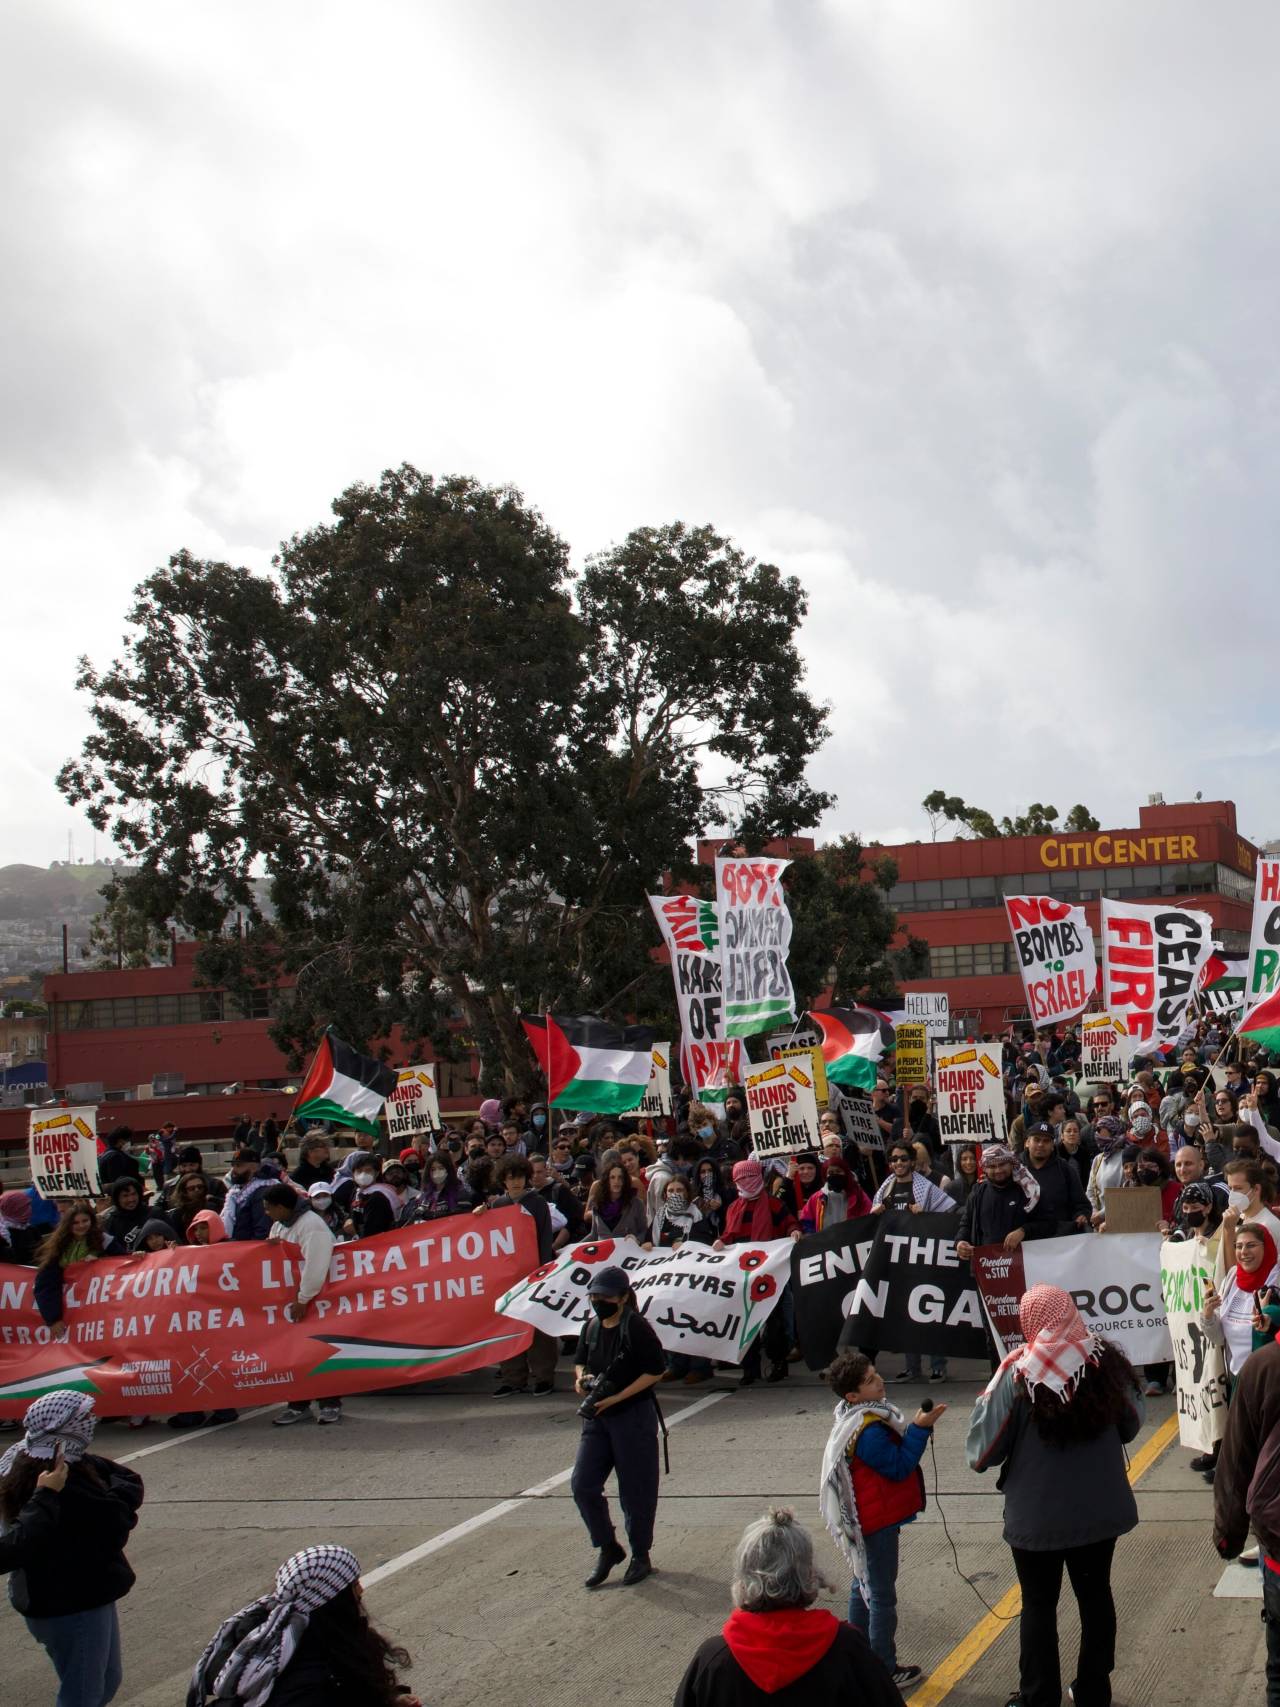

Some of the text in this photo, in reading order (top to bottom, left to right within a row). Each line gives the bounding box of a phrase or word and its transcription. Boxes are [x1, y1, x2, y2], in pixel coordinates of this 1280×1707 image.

[1007, 897, 1072, 930] NO
[1016, 922, 1084, 967] BOMBS
[1044, 960, 1065, 973] TO
[1107, 917, 1155, 1042] FIRE
[1027, 969, 1088, 1020] ISRAEL
[907, 996, 948, 1016] HELL NO
[1083, 1031, 1117, 1047] HANDS
[1090, 1046, 1110, 1062] OFF
[1084, 1061, 1119, 1078] RAFAH!
[938, 1069, 985, 1092] HANDS
[747, 1082, 797, 1110] HANDS
[840, 1098, 873, 1114] CEASE
[949, 1091, 977, 1114] OFF
[395, 1100, 416, 1118] OFF
[762, 1105, 789, 1129] OFF
[389, 1113, 430, 1133] RAFAH!
[850, 1115, 873, 1130] FIRE
[940, 1113, 991, 1135] RAFAH!
[33, 1132, 80, 1156] HANDS
[754, 1123, 806, 1151] RAFAH!
[853, 1131, 883, 1146] NOW!
[44, 1153, 72, 1174] OFF
[37, 1171, 89, 1192] RAFAH!
[694, 1252, 726, 1266] TO
[884, 1234, 960, 1268] THE
[86, 1264, 200, 1305] RETURN
[218, 1262, 240, 1292] &
[261, 1226, 516, 1289] LIERATION
[980, 1256, 1013, 1268] Freedom
[991, 1267, 1009, 1280] STAY
[629, 1272, 737, 1299] MARTYRS
[77, 1320, 104, 1343] THE
[112, 1314, 156, 1338] BAY
[168, 1307, 246, 1333] AREA
[315, 1275, 485, 1319] PALESTINE
[985, 1294, 1017, 1306] Freedom
[998, 1304, 1021, 1317] RETUR
[656, 1306, 742, 1341] المجد
[1137, 1318, 1145, 1329] &
[231, 1350, 260, 1363] حركة
[139, 1373, 171, 1385] YOUTH
[121, 1384, 173, 1397] MOVEMENT
